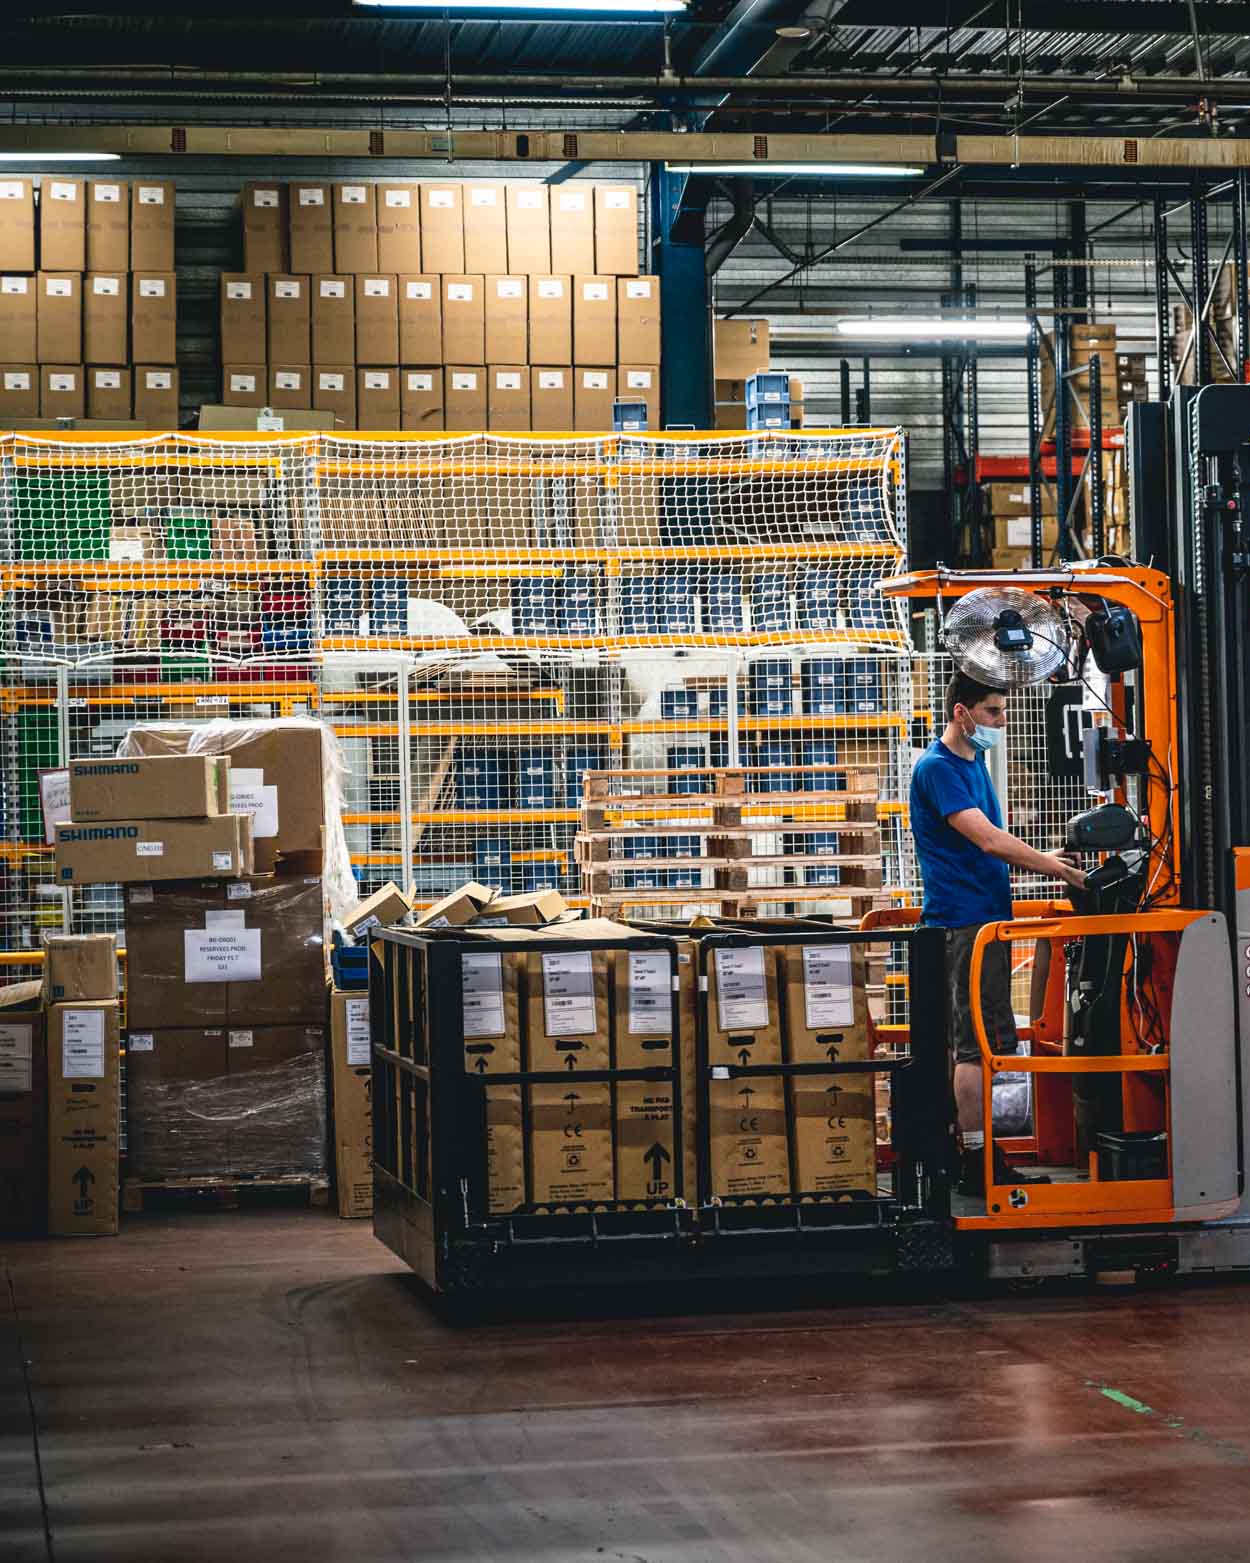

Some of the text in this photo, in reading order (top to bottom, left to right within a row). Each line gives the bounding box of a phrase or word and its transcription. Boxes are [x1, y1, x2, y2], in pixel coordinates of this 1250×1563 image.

[75, 763, 139, 776] SHIMANO
[59, 826, 138, 842] SHIMANO
[647, 1182, 669, 1195] UP
